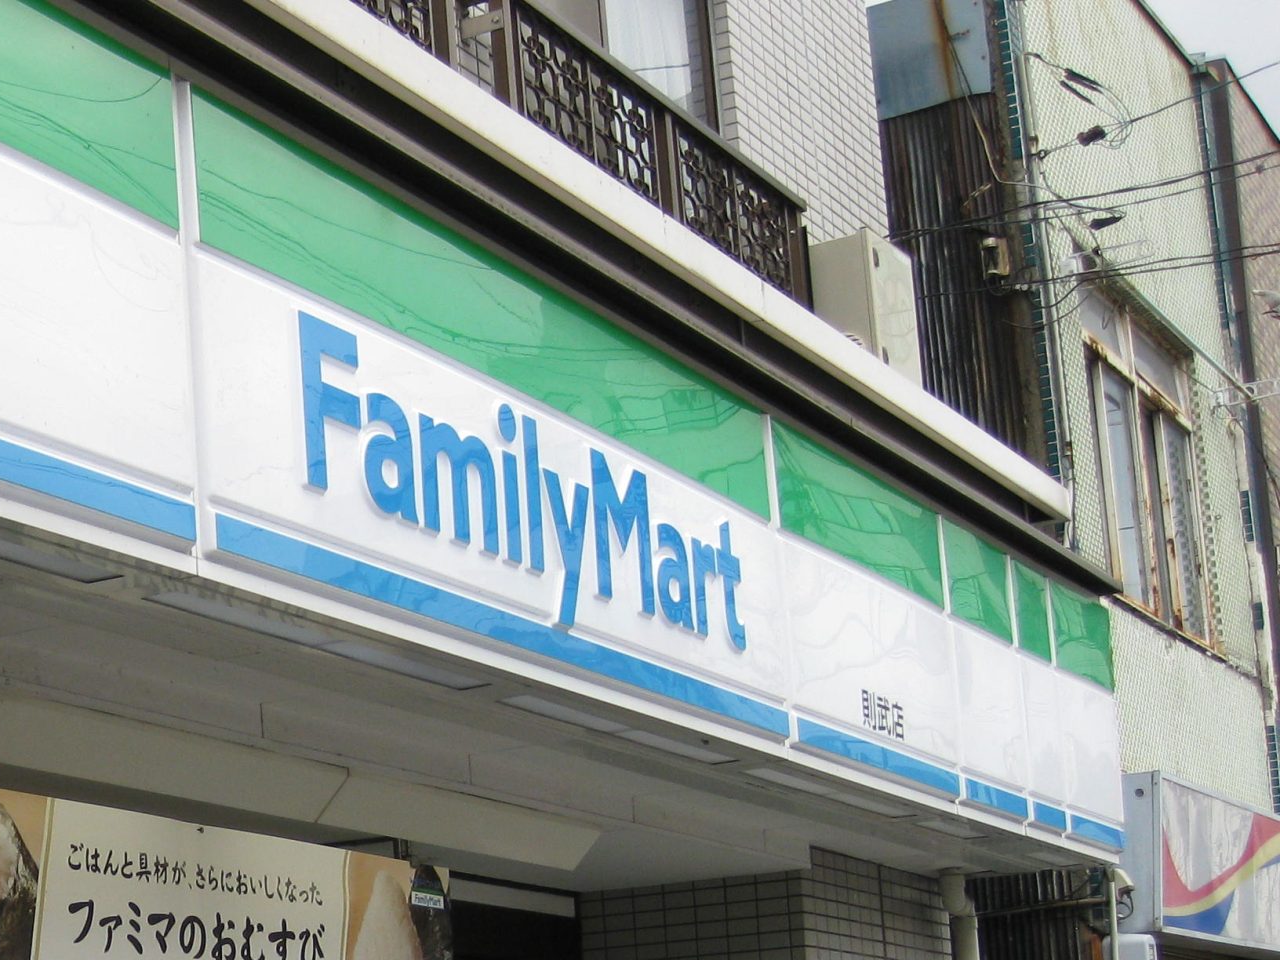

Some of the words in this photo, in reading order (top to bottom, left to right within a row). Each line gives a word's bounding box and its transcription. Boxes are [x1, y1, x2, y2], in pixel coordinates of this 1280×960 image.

[297, 309, 749, 654] FamilyMart
[861, 688, 905, 741] 則武店
[67, 843, 324, 907] ごはんと具材が、さらにおいしくなった
